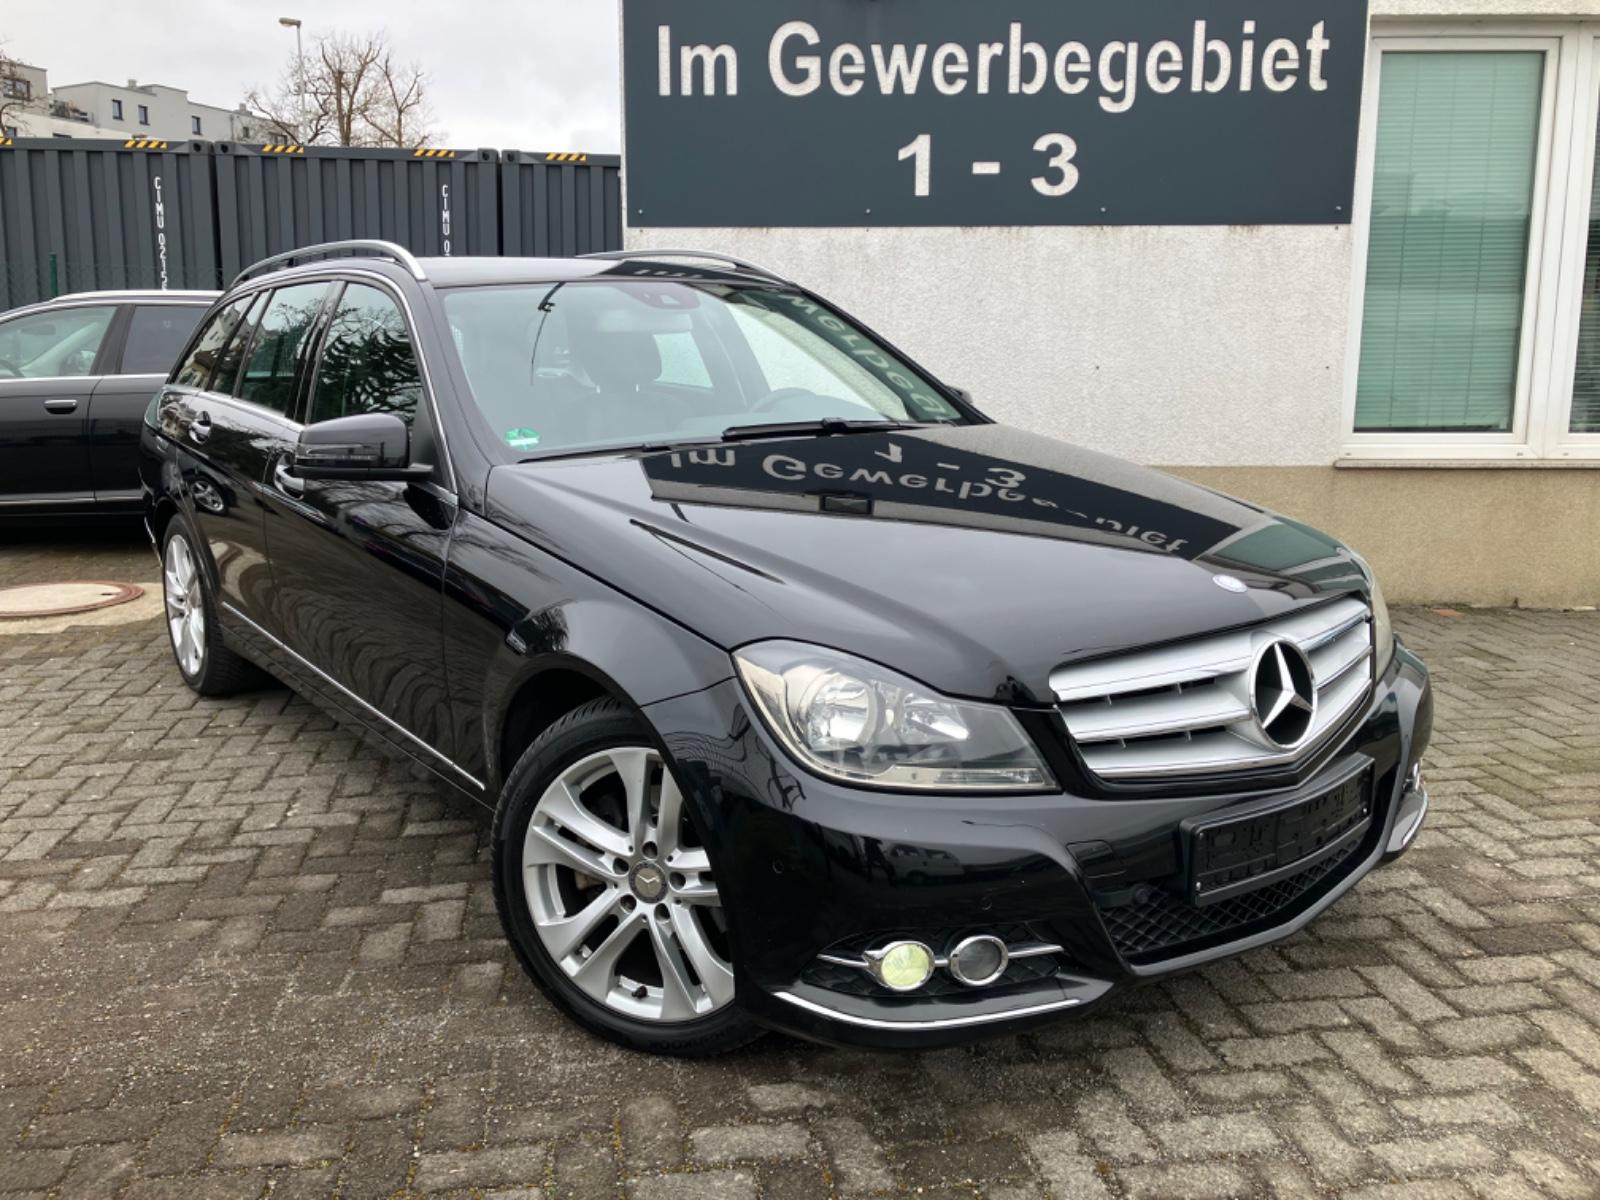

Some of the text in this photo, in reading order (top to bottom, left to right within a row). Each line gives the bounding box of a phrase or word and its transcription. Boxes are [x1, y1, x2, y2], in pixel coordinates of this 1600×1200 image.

[658, 20, 1330, 114] Im Gewerbegebiet
[898, 134, 931, 197] 1
[1030, 132, 1079, 197] 3
[154, 175, 165, 229] CIMU
[442, 183, 450, 236] CIMU
